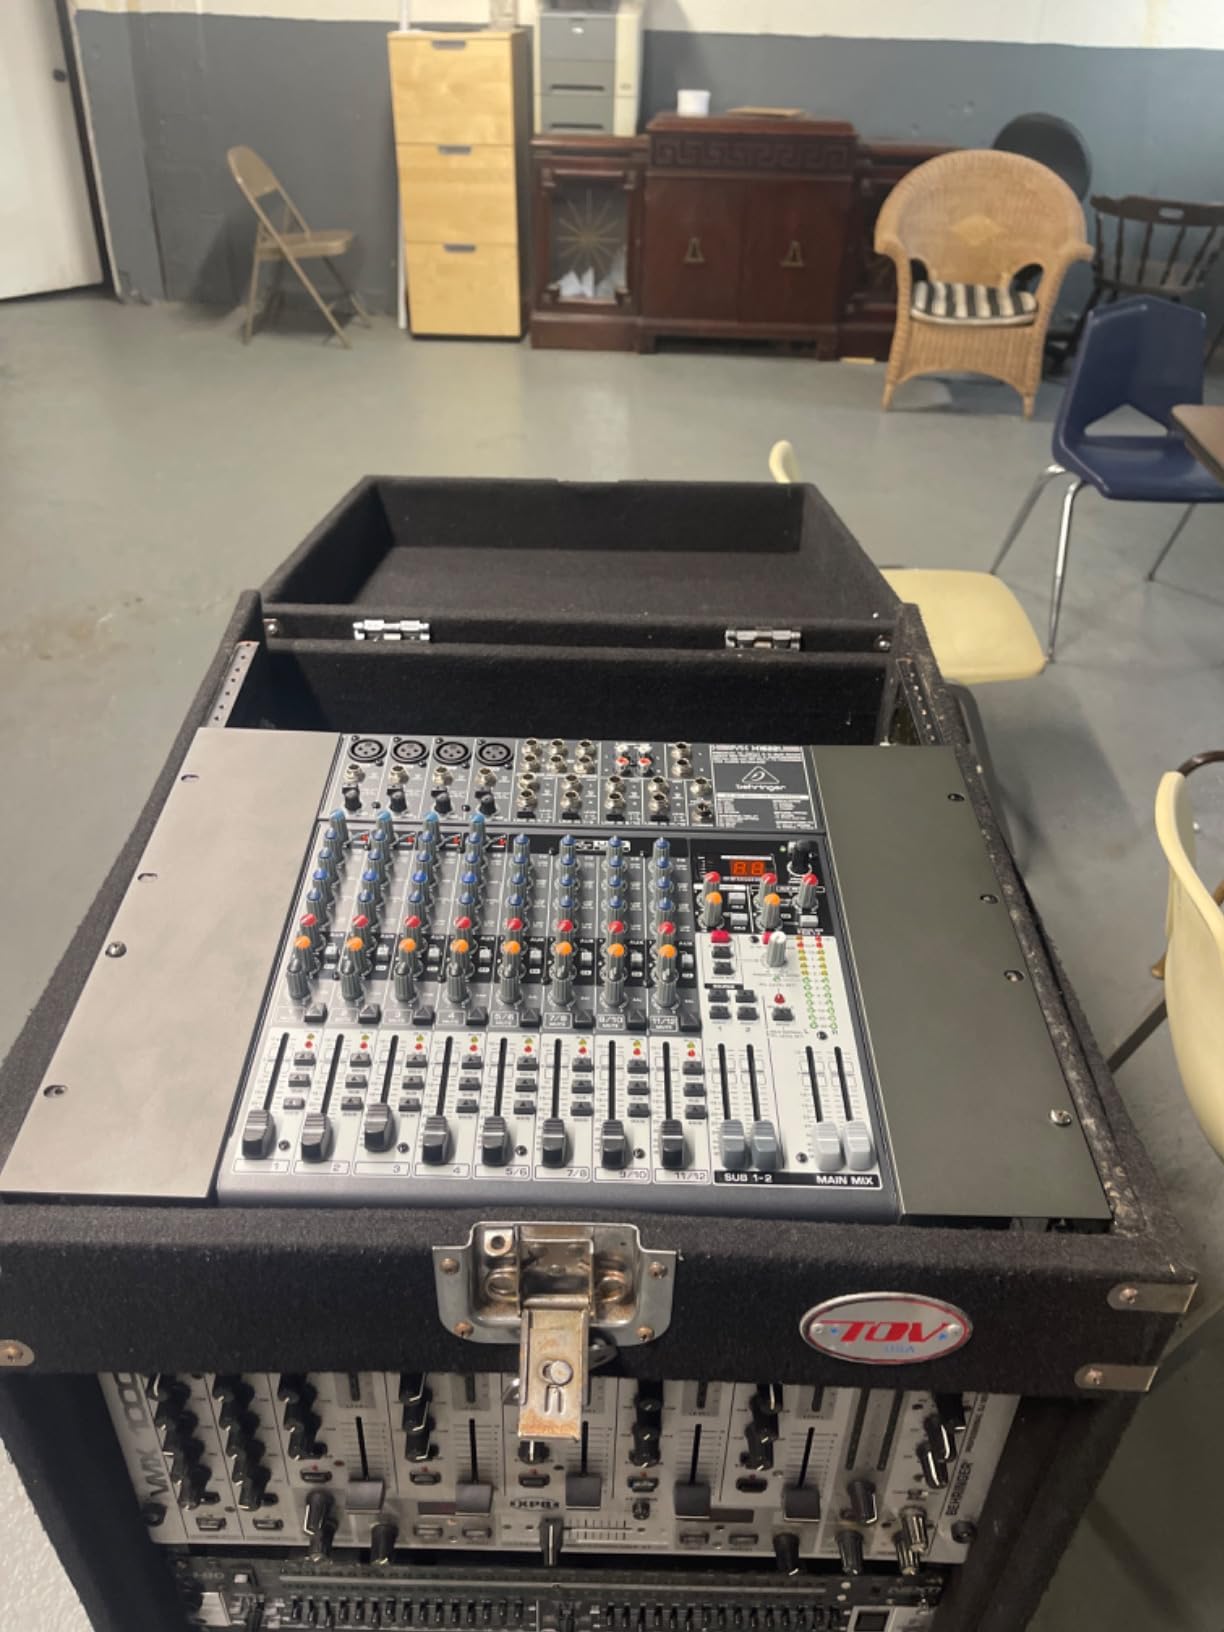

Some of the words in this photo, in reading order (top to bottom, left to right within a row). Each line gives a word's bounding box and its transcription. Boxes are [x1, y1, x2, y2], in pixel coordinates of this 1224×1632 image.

[333, 1163, 342, 1172] 2
[392, 1164, 401, 1174] 3
[452, 1166, 461, 1174] 4
[504, 1167, 528, 1177] 5/6
[567, 1168, 588, 1178] 7/8
[674, 1171, 707, 1181] 11/12
[724, 1172, 748, 1182] SUB
[752, 1174, 773, 1183] 1-2
[816, 1175, 847, 1185] MAIN
[851, 1176, 874, 1185] MIX
[820, 1319, 949, 1343] TOV
[945, 1461, 974, 1516] BEHRINGER
